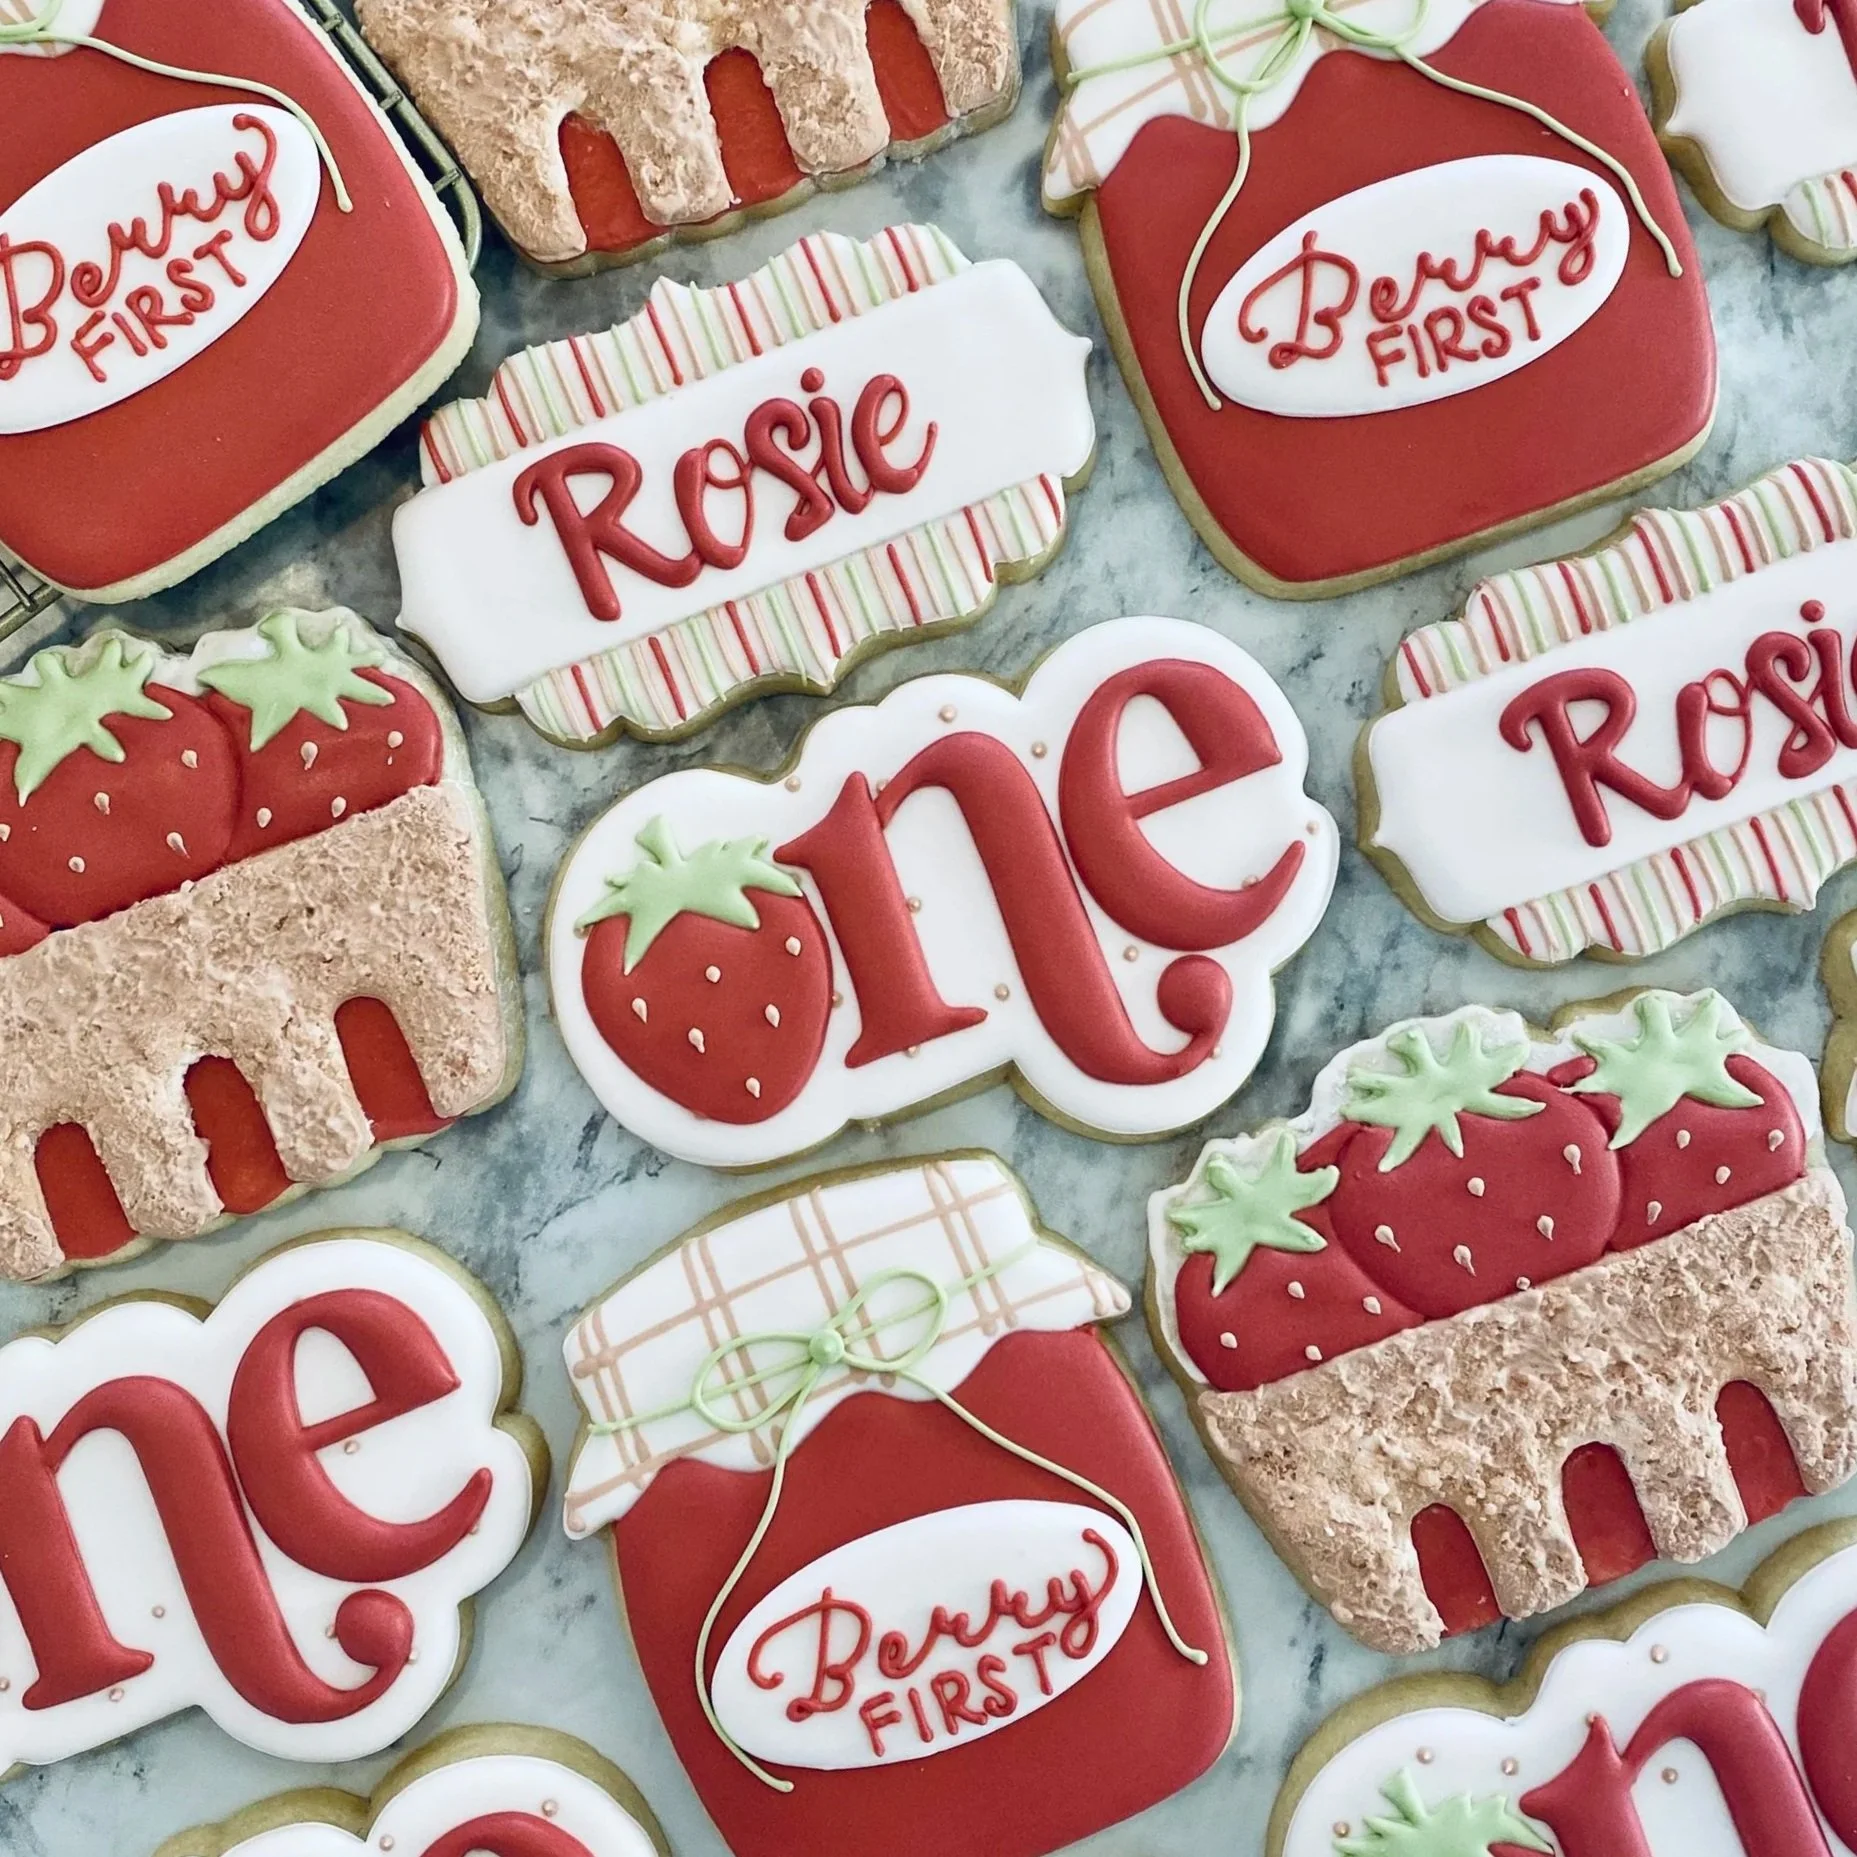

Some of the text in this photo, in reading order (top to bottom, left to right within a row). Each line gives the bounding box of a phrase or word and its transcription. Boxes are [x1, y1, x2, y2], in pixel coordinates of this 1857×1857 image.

[0, 113, 279, 380] Berry
[70, 229, 246, 382] FIRST
[1238, 187, 1600, 369] Berry
[1366, 276, 1542, 387] FIRST
[512, 367, 938, 621] Rosie
[1499, 599, 1857, 848] Rosi
[747, 1528, 1119, 1722] Berry
[859, 1631, 1057, 1757] FIRST
